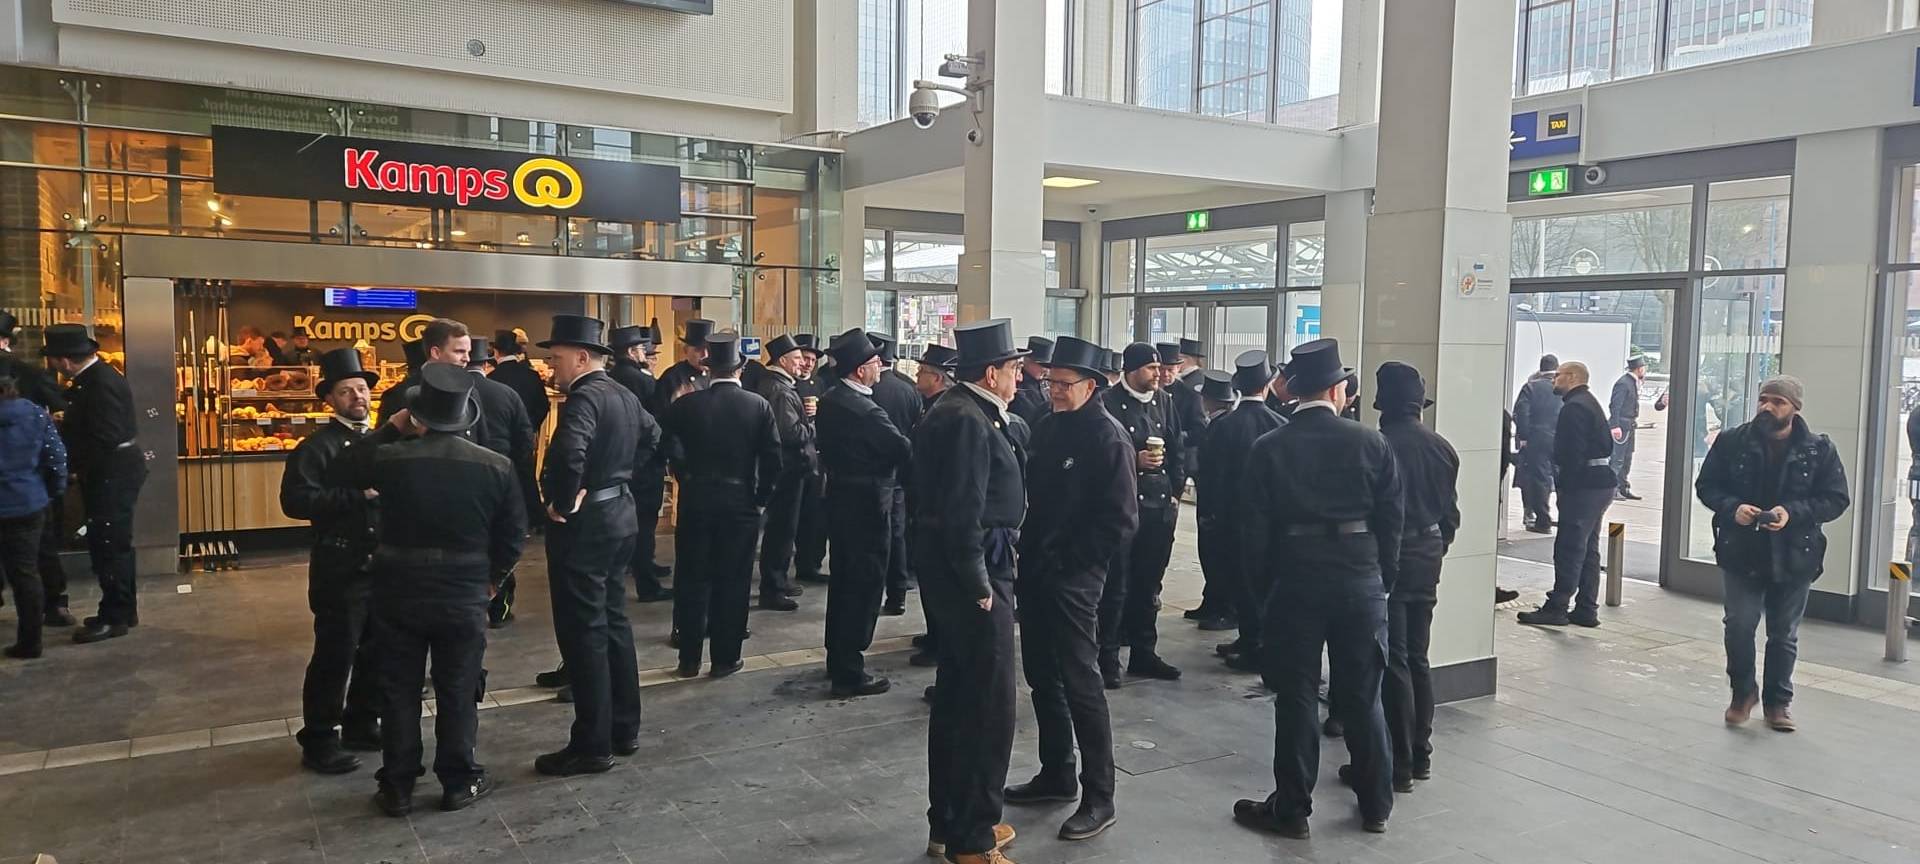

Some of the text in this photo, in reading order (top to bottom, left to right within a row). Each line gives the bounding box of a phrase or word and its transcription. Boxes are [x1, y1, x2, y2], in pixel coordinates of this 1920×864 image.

[1551, 120, 1567, 129] TAXI
[345, 148, 509, 206] Kamps
[294, 315, 397, 345] Kamps
